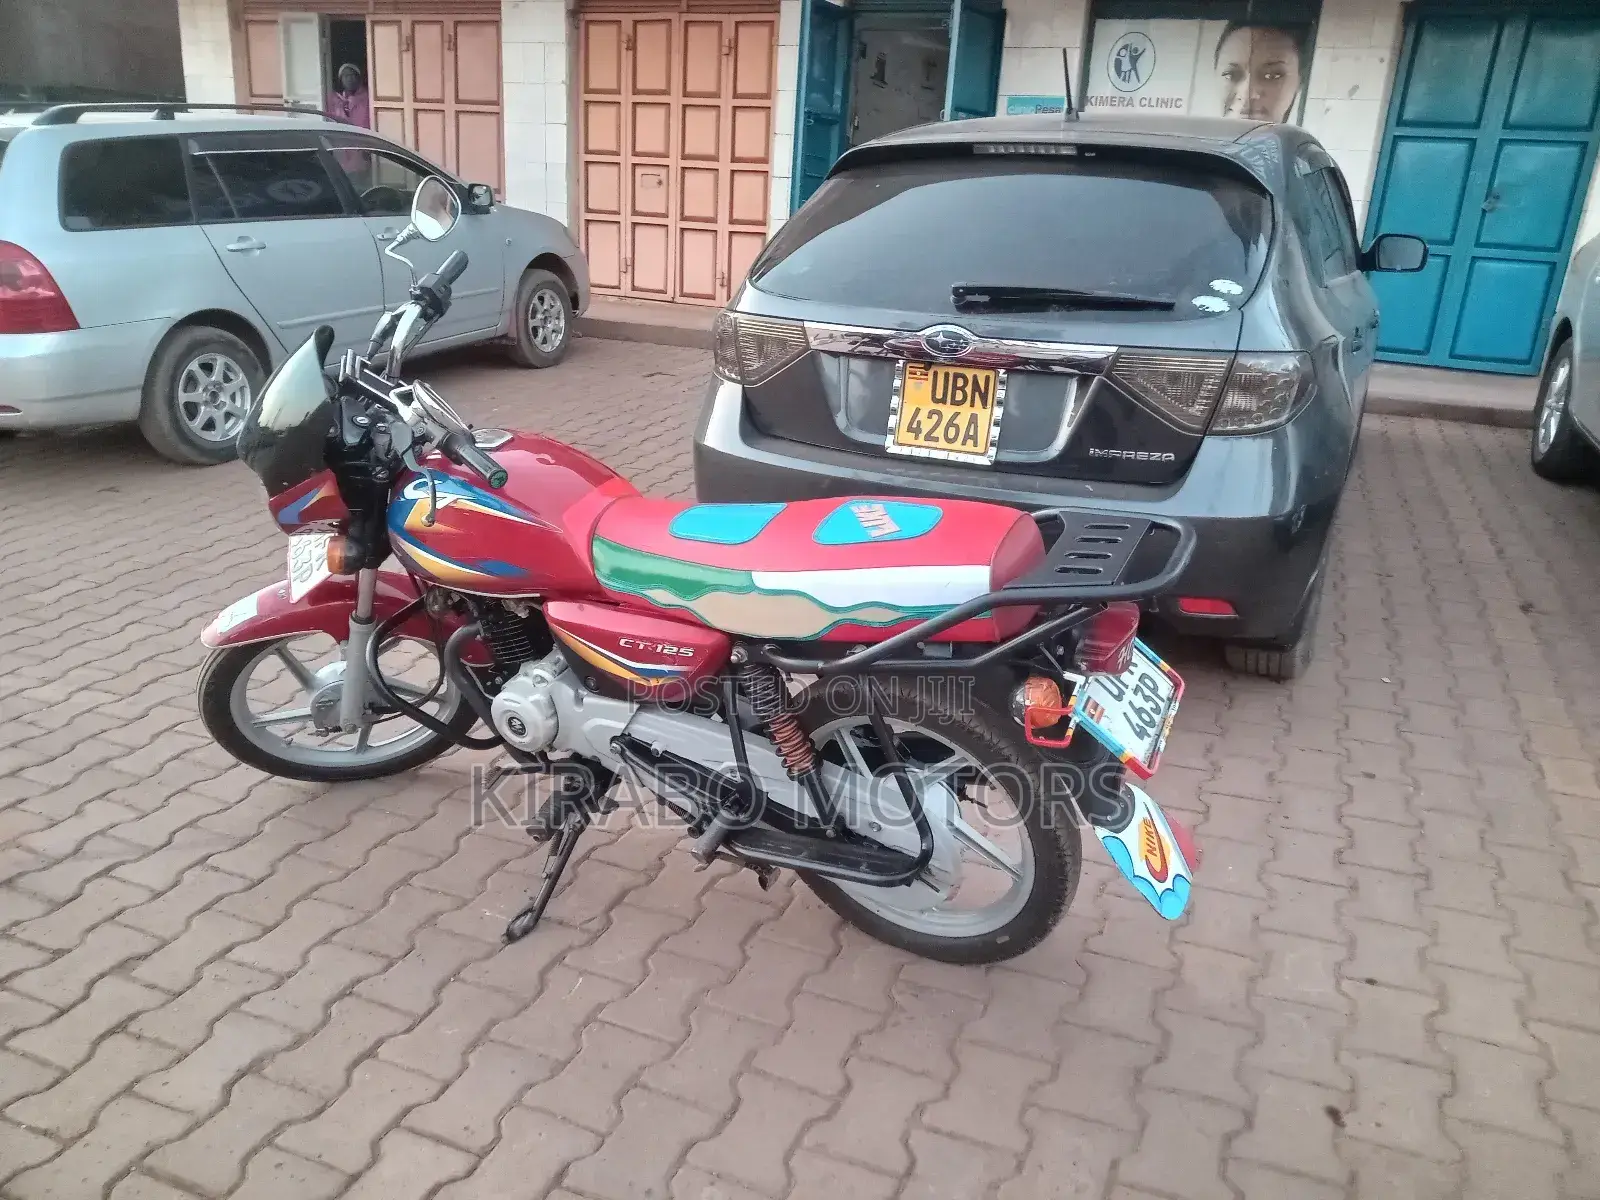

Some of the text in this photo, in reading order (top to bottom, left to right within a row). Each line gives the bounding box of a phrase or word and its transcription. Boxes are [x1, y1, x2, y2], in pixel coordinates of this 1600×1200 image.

[1088, 95, 1183, 108] KIMERA CLINIC
[931, 370, 990, 409] UBN
[906, 407, 978, 447] 426A
[1088, 448, 1175, 461] IMPREZA
[1122, 672, 1166, 740] 463P
[1143, 817, 1157, 857] NIKE
